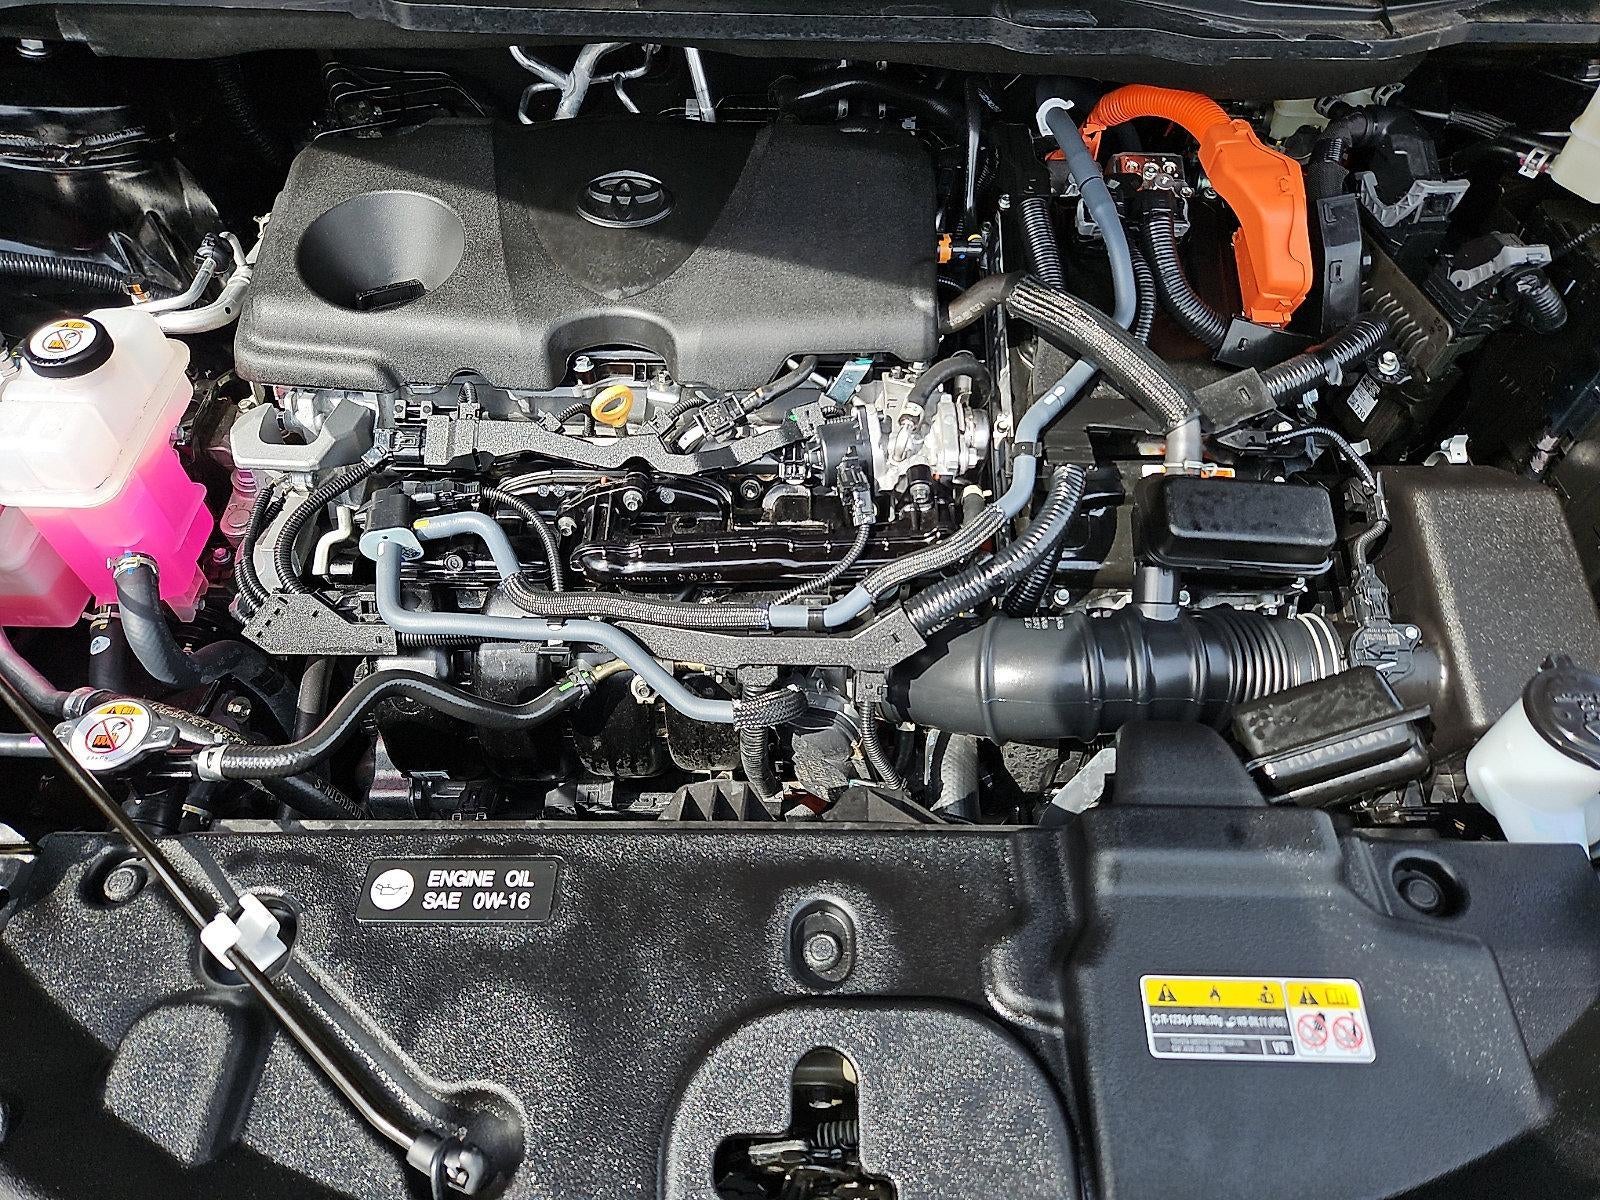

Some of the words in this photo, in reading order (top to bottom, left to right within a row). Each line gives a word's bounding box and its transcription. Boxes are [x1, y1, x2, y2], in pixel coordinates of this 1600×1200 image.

[427, 869, 496, 888] ENGINE
[504, 869, 535, 888] OIL
[421, 891, 463, 910] SAE
[472, 891, 531, 910] 0W-16
